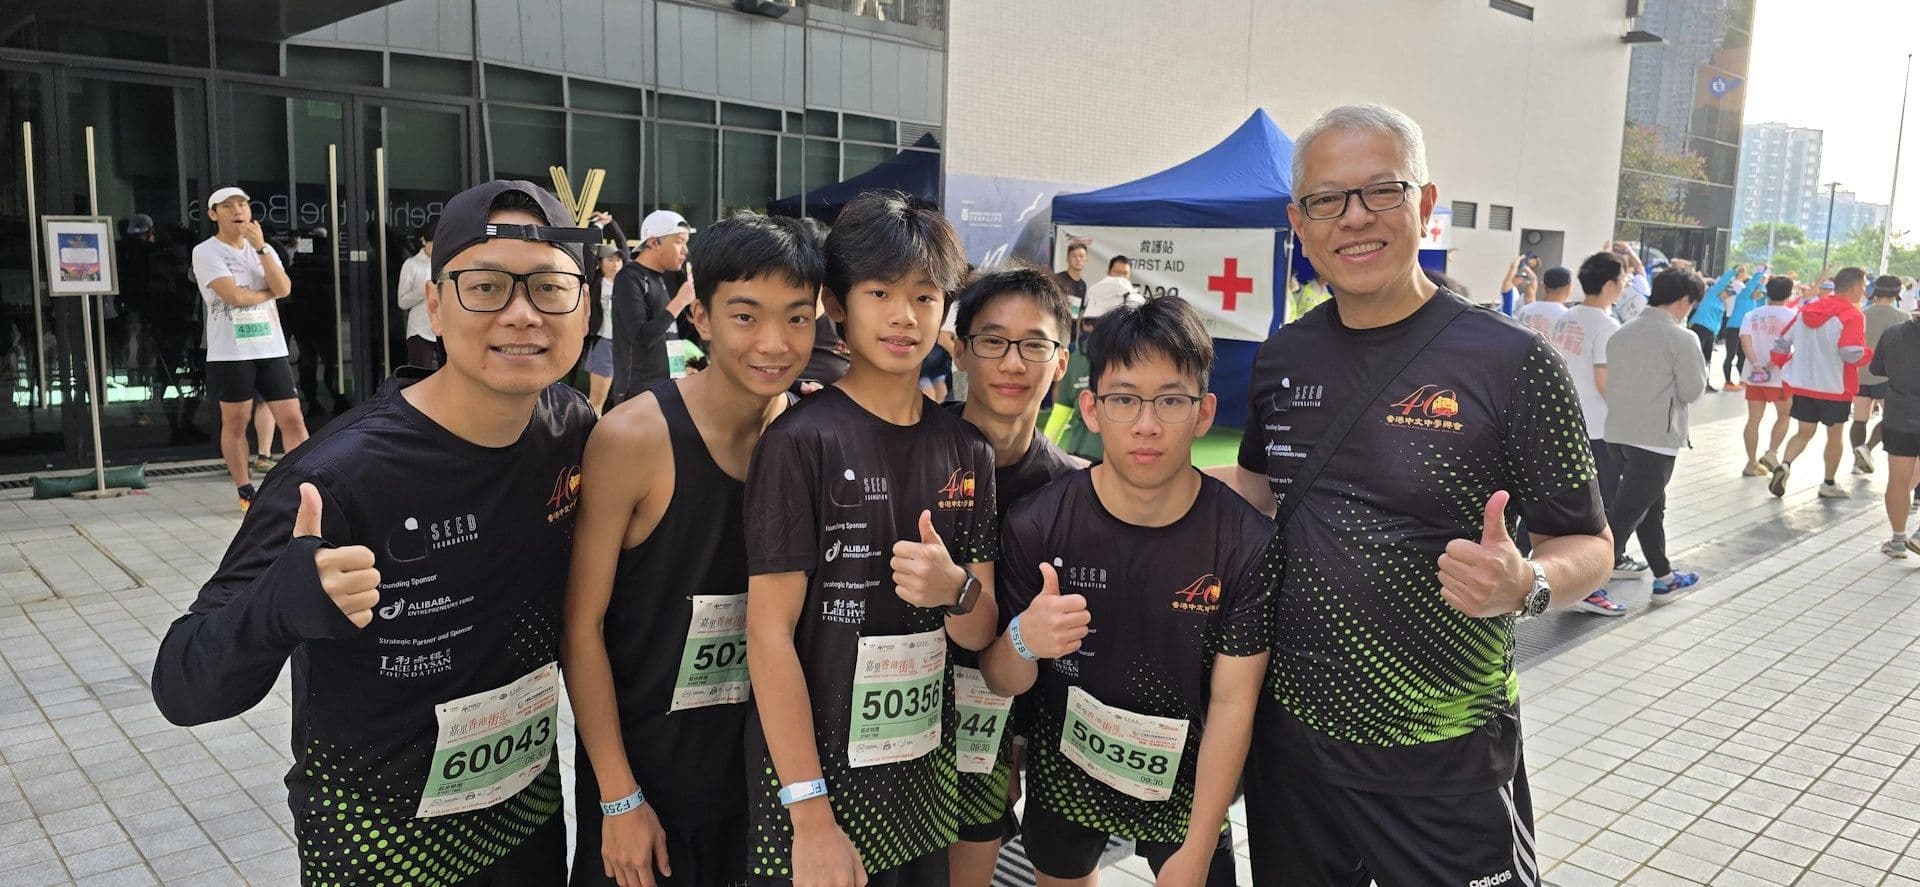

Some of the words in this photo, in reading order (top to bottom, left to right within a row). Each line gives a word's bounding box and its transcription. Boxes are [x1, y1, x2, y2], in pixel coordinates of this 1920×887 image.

[1140, 240, 1174, 254] 救護站
[1130, 258, 1162, 271] FIRST
[1163, 260, 1185, 272] AID
[431, 513, 477, 541] SEED
[411, 574, 438, 587] Sponsor
[1069, 566, 1107, 582] SEED
[408, 596, 451, 611] ALIBABA
[379, 664, 452, 679] FOUNDATION
[380, 655, 411, 673] LEE
[413, 656, 452, 671] HYSAN
[862, 679, 940, 721] 50356
[442, 716, 550, 780] 60043
[970, 743, 990, 752] 09:30
[1072, 720, 1168, 775] 50358
[1141, 776, 1163, 786] 09:30
[1469, 870, 1512, 887] adidas
